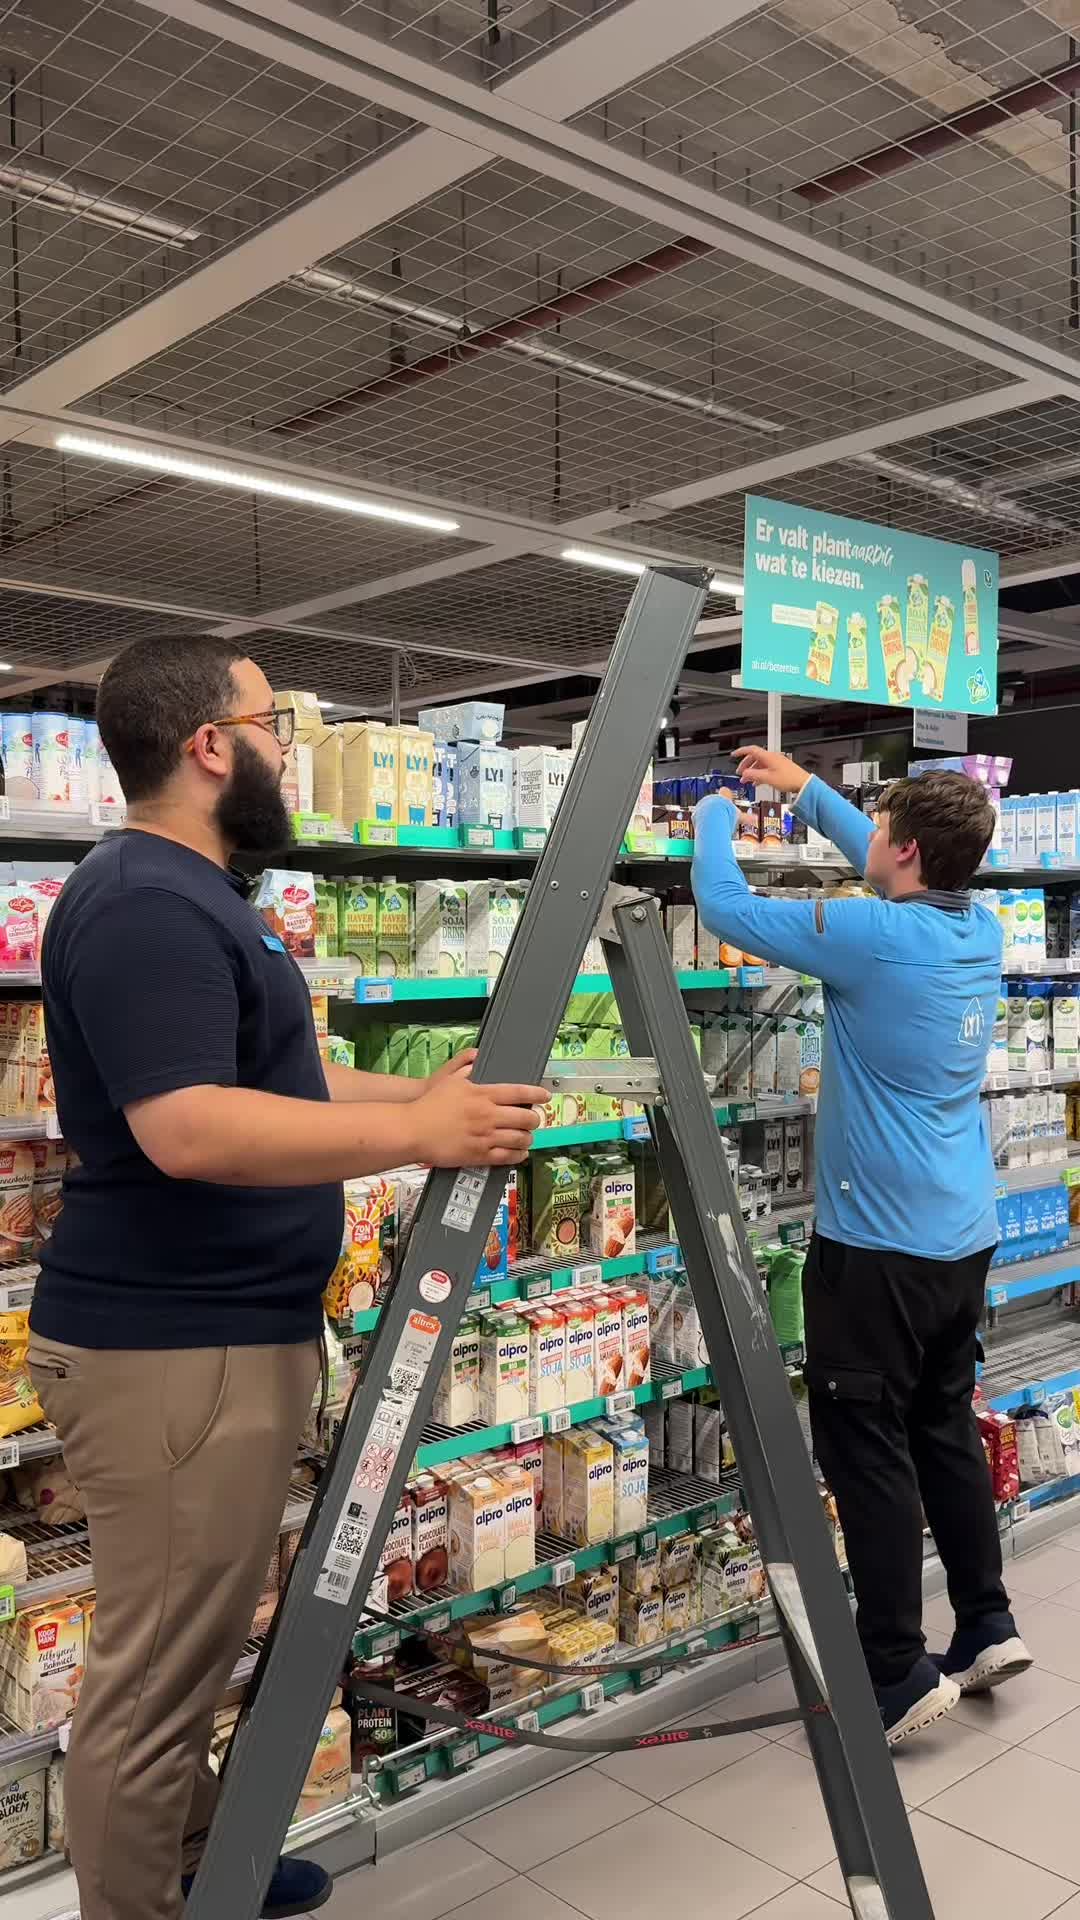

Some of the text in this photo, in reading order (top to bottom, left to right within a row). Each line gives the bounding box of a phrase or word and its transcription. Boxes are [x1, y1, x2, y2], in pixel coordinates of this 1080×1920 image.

[756, 518, 774, 543] Er
[778, 525, 809, 551] valt
[755, 551, 864, 590] wat te kiezen.
[373, 752, 394, 768] LY!
[406, 754, 429, 771] LY!
[485, 768, 503, 782] LY!
[549, 772, 564, 786] LY!
[347, 914, 374, 923] HAVER
[382, 914, 408, 923] HAVER
[442, 916, 465, 925] SOJA
[492, 916, 515, 925] SOJA
[442, 927, 465, 938] DRINK
[492, 927, 514, 938] DRIN
[605, 1182, 633, 1195] alpro
[554, 1193, 578, 1204] DRINK
[412, 1317, 437, 1331] altrex
[597, 1322, 620, 1337] alpro
[627, 1315, 648, 1329] alpro
[540, 1337, 564, 1352] alpro
[569, 1330, 593, 1344] alpro
[343, 1344, 362, 1360] lpro
[453, 1343, 478, 1358] alpro
[498, 1344, 528, 1359] alpro
[541, 1360, 563, 1376] SOJA
[570, 1354, 593, 1369] SOJA
[589, 1465, 612, 1480] alpro
[623, 1458, 647, 1473] alpro
[623, 1480, 646, 1497] SOJA
[506, 1497, 532, 1512] alpro
[419, 1506, 446, 1523] alpro
[476, 1510, 503, 1525] alpro
[391, 1517, 410, 1534] pro
[419, 1526, 446, 1542] CHOCOLATE
[386, 1536, 410, 1552] HOCOLATE
[674, 1544, 690, 1557] alpro
[725, 1562, 749, 1578] alpro
[588, 1592, 611, 1608] alpro
[669, 1592, 686, 1604] alpro
[642, 1602, 659, 1614] alpro
[490, 1664, 512, 1675] alpro
[403, 1671, 438, 1686] alpro
[493, 1689, 512, 1700] alpro
[358, 1708, 392, 1718] PLANT
[358, 1718, 392, 1728] PROTEIN
[464, 1719, 517, 1738] altrex
[636, 1731, 690, 1746] altrex
[0, 1791, 29, 1808] TARWE
